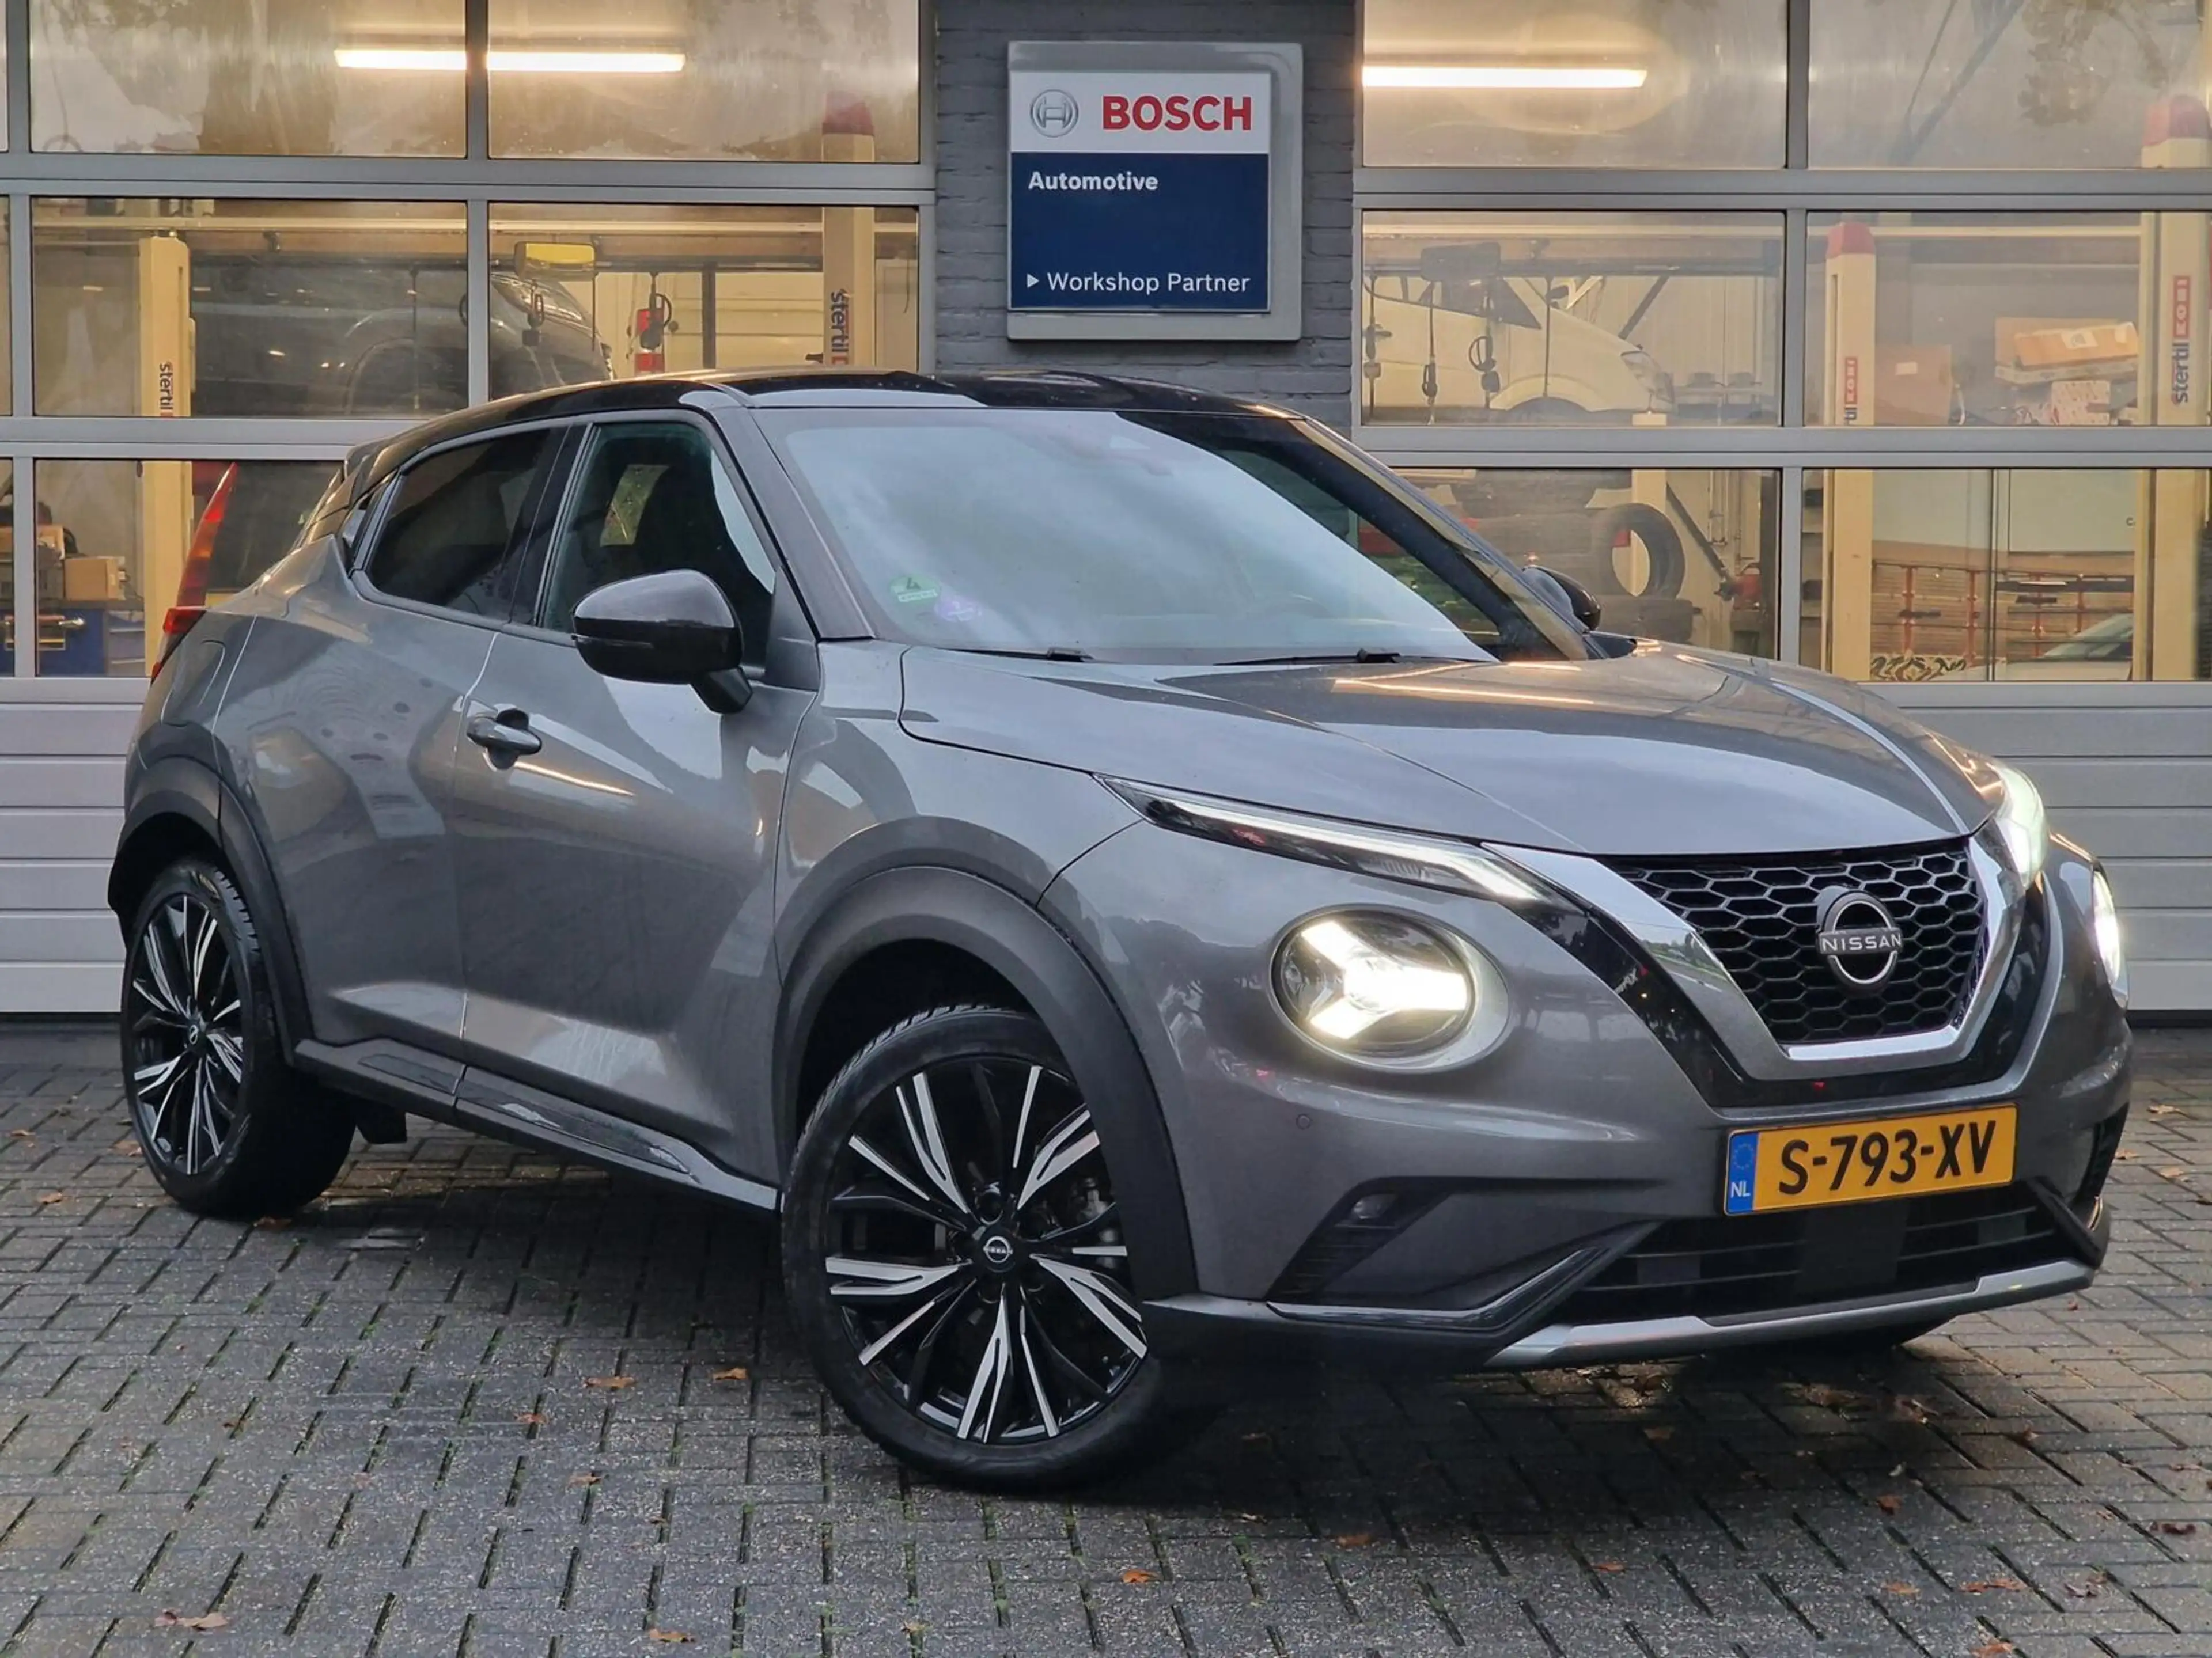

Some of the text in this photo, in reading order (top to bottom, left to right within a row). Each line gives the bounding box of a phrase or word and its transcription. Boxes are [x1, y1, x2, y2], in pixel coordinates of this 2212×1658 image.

[1102, 95, 1252, 131] BOSCH
[1028, 170, 1159, 191] Automotive
[1047, 272, 1251, 294] Workshop Partner
[830, 289, 849, 353] stertil
[159, 361, 173, 410] stertil
[2172, 342, 2189, 405] stertil
[1821, 933, 1902, 951] NISSAN
[1778, 1120, 1997, 1195] S-793-XV
[1730, 1181, 1751, 1198] NL
